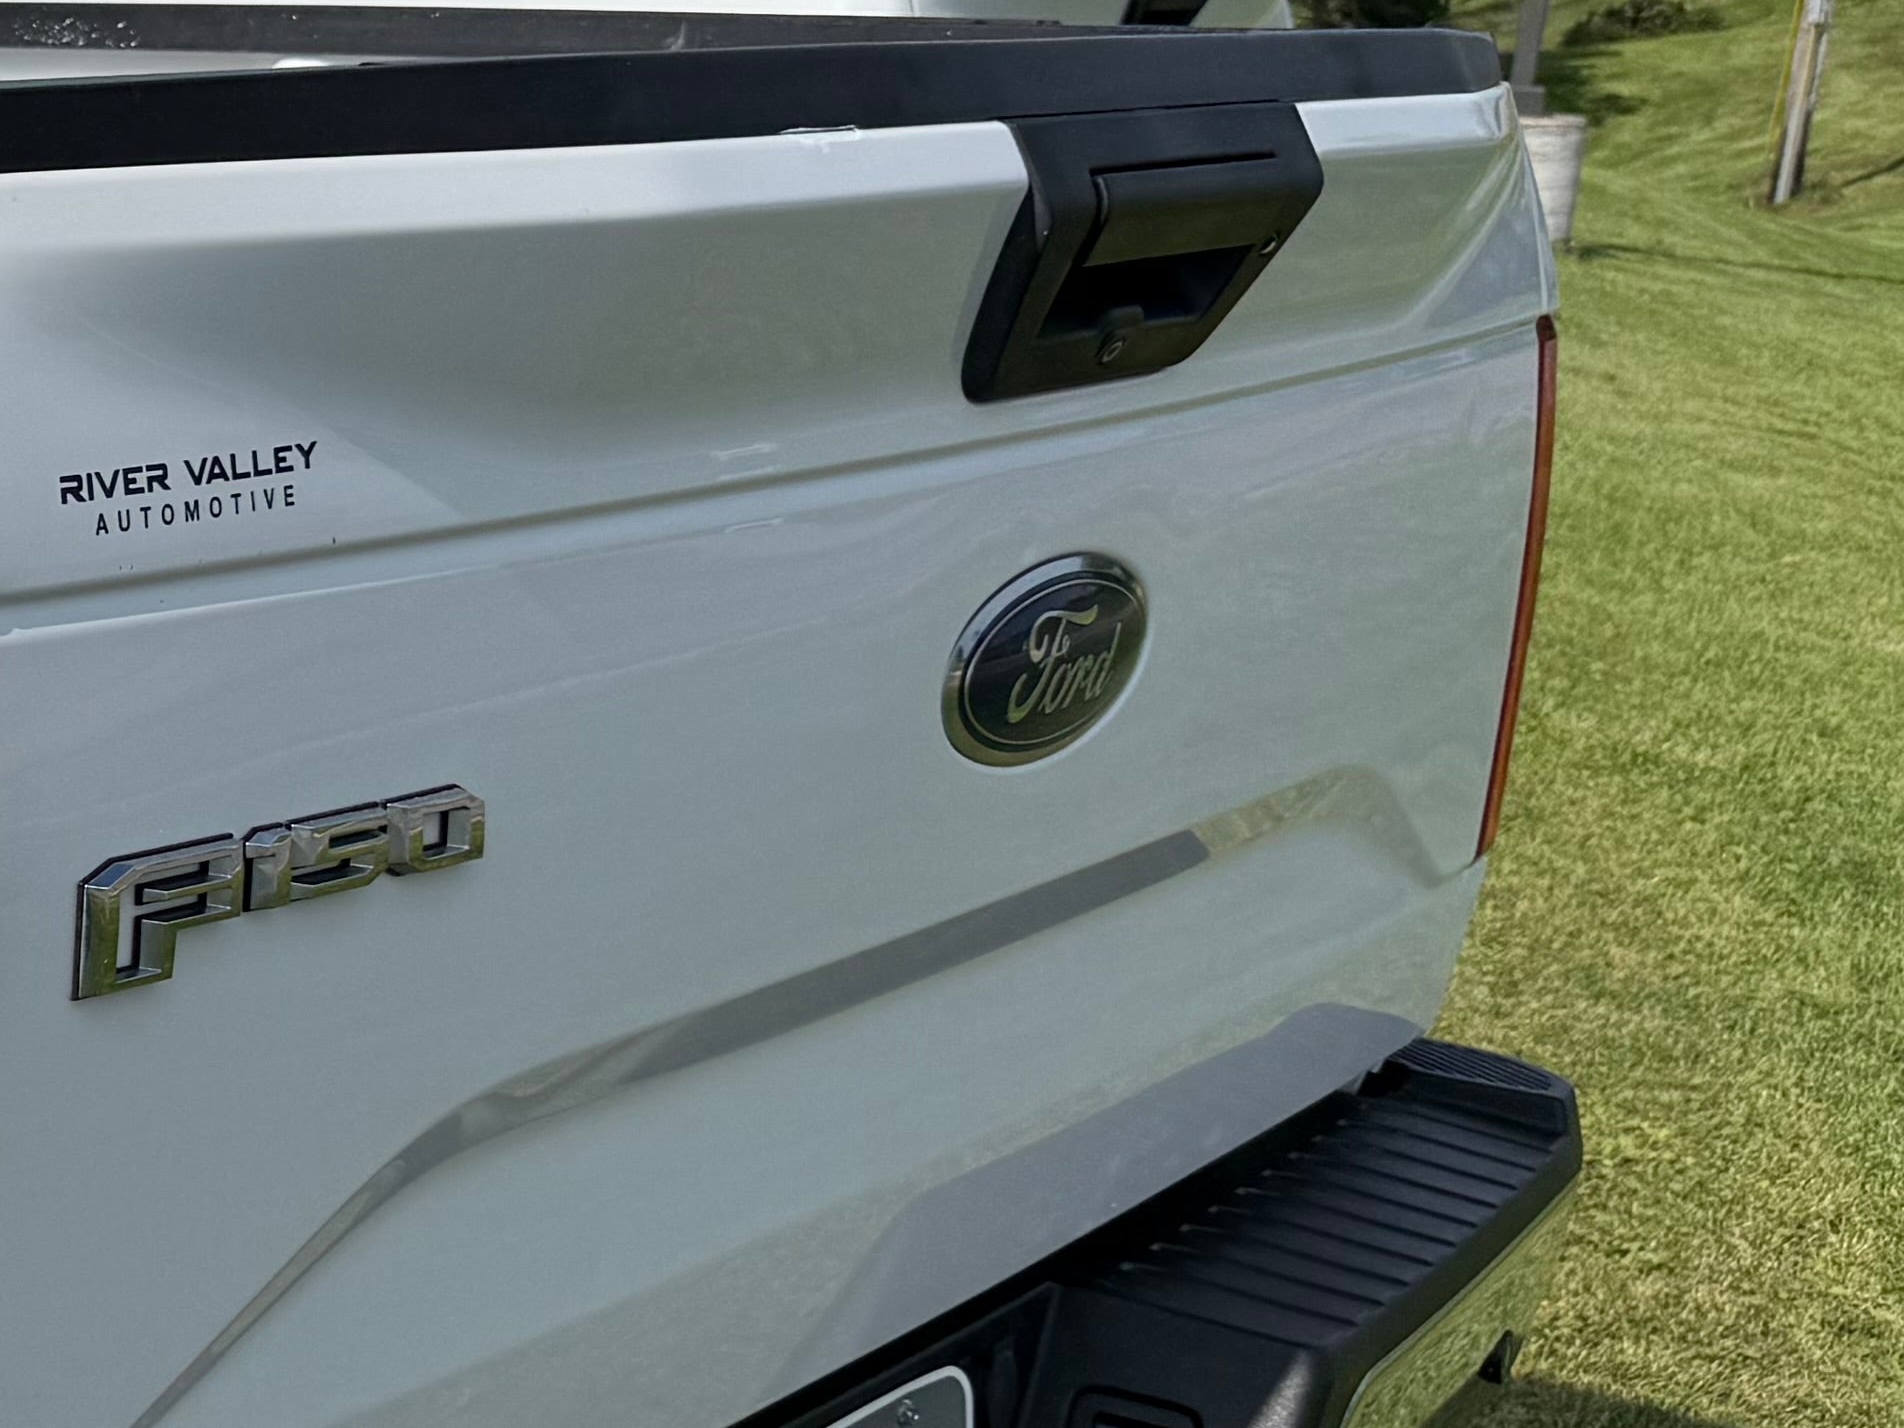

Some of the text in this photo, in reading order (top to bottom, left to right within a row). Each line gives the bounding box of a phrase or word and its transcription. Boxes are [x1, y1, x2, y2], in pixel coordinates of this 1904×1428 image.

[59, 440, 318, 505] RIVER VALLEY
[95, 484, 296, 536] AUTOMOTIVE
